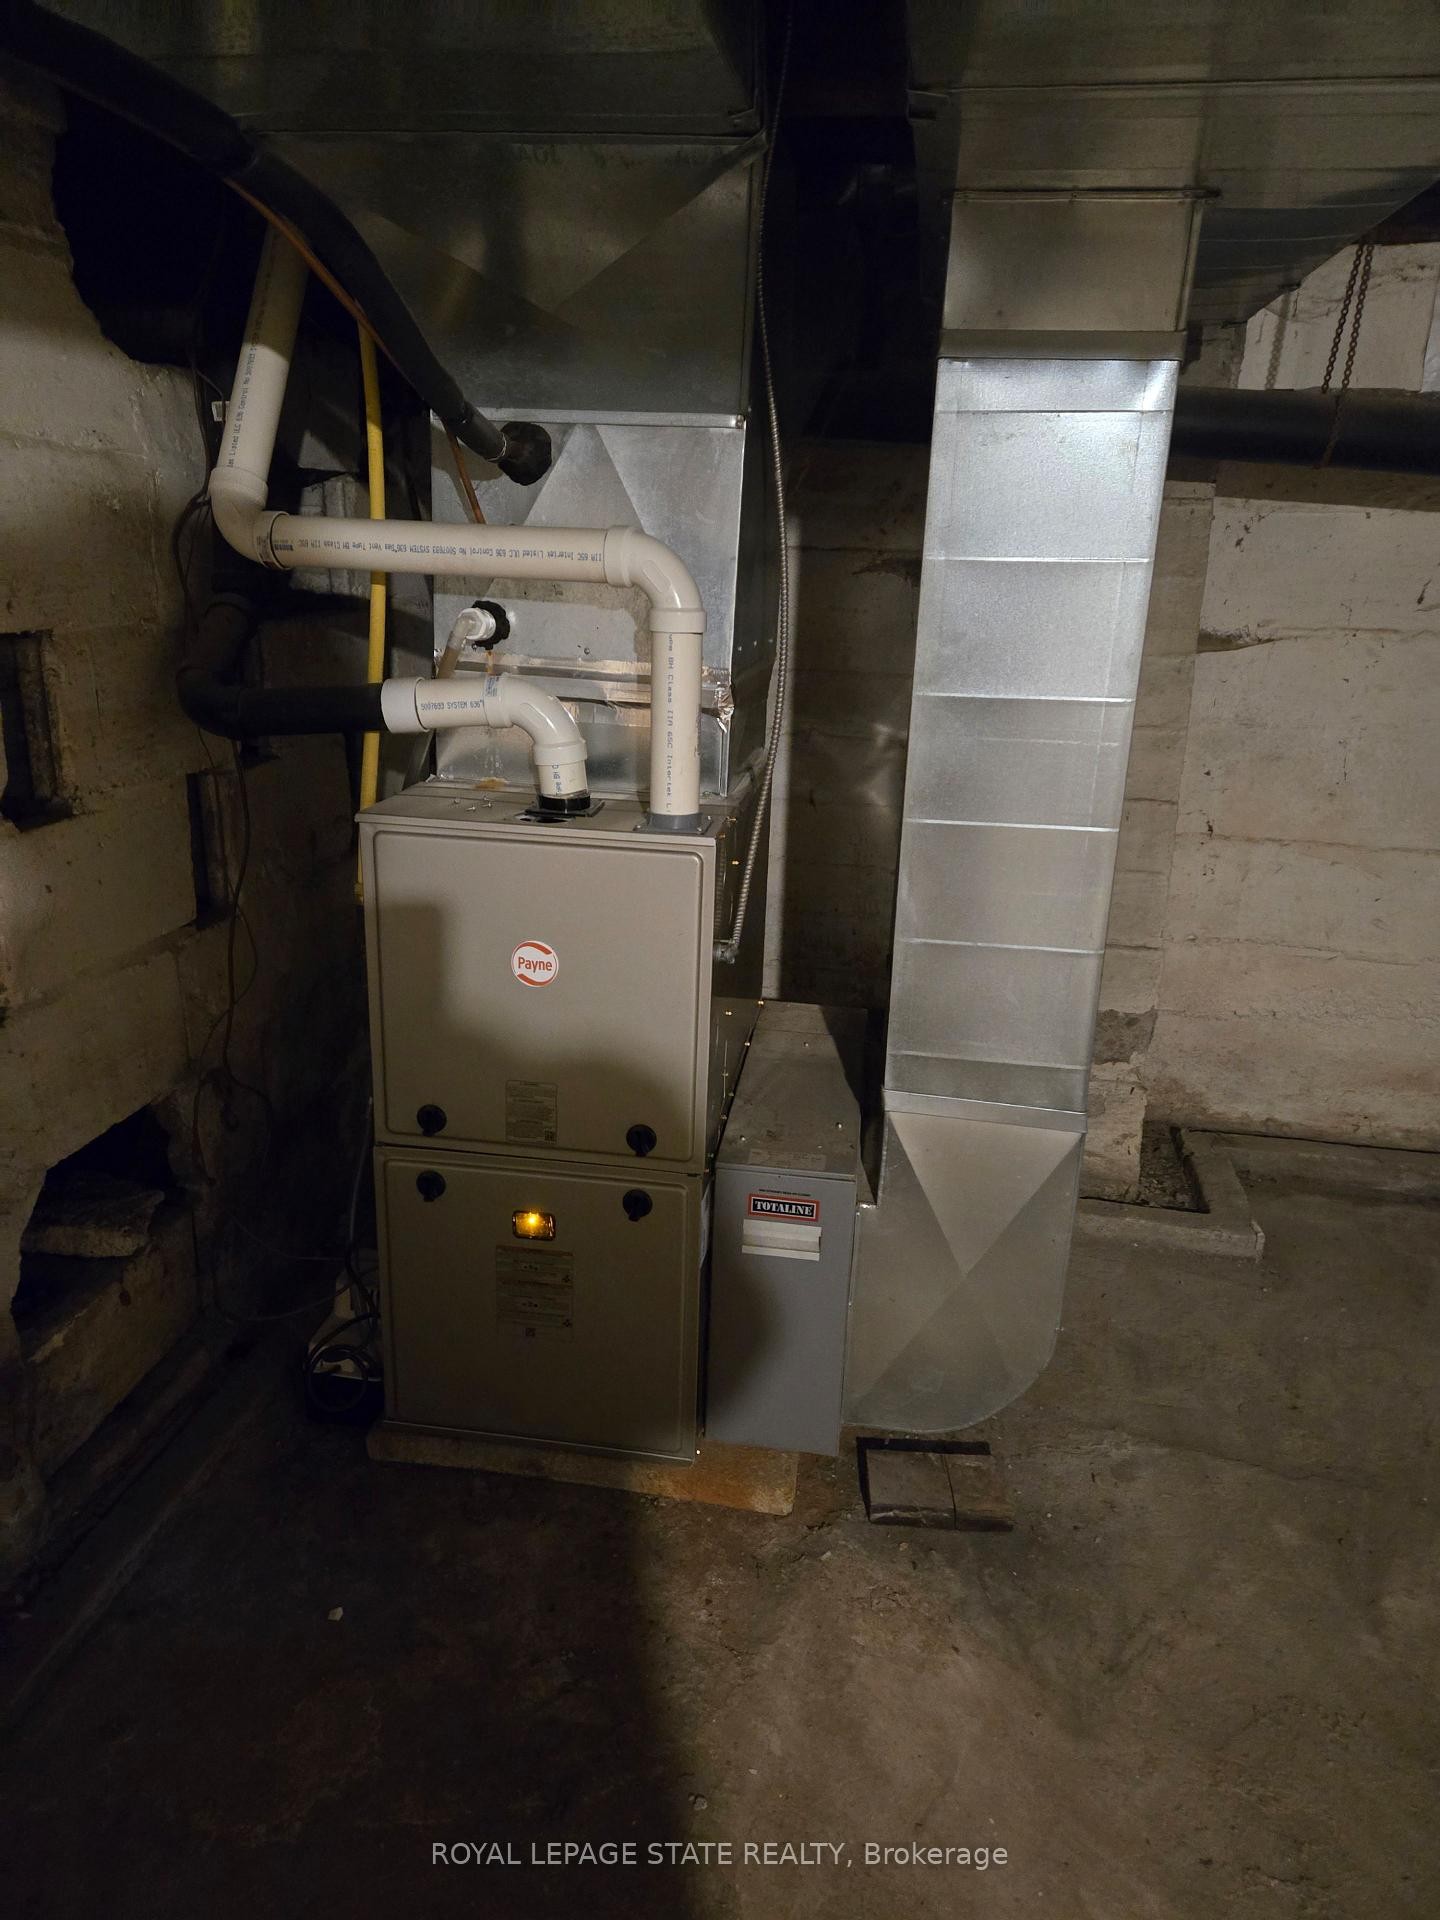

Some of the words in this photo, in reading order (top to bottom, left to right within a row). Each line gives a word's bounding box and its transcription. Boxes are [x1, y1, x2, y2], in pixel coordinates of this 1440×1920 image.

[368, 542, 383, 551] Vent
[409, 544, 431, 554] SYSTEM
[469, 547, 494, 557] Control
[509, 550, 520, 559] ULC
[523, 551, 544, 559] Listed
[547, 551, 574, 561] Intertek
[447, 701, 468, 710] SYSTEM
[518, 956, 553, 974] Payne
[754, 1200, 813, 1216] TOTALINE
